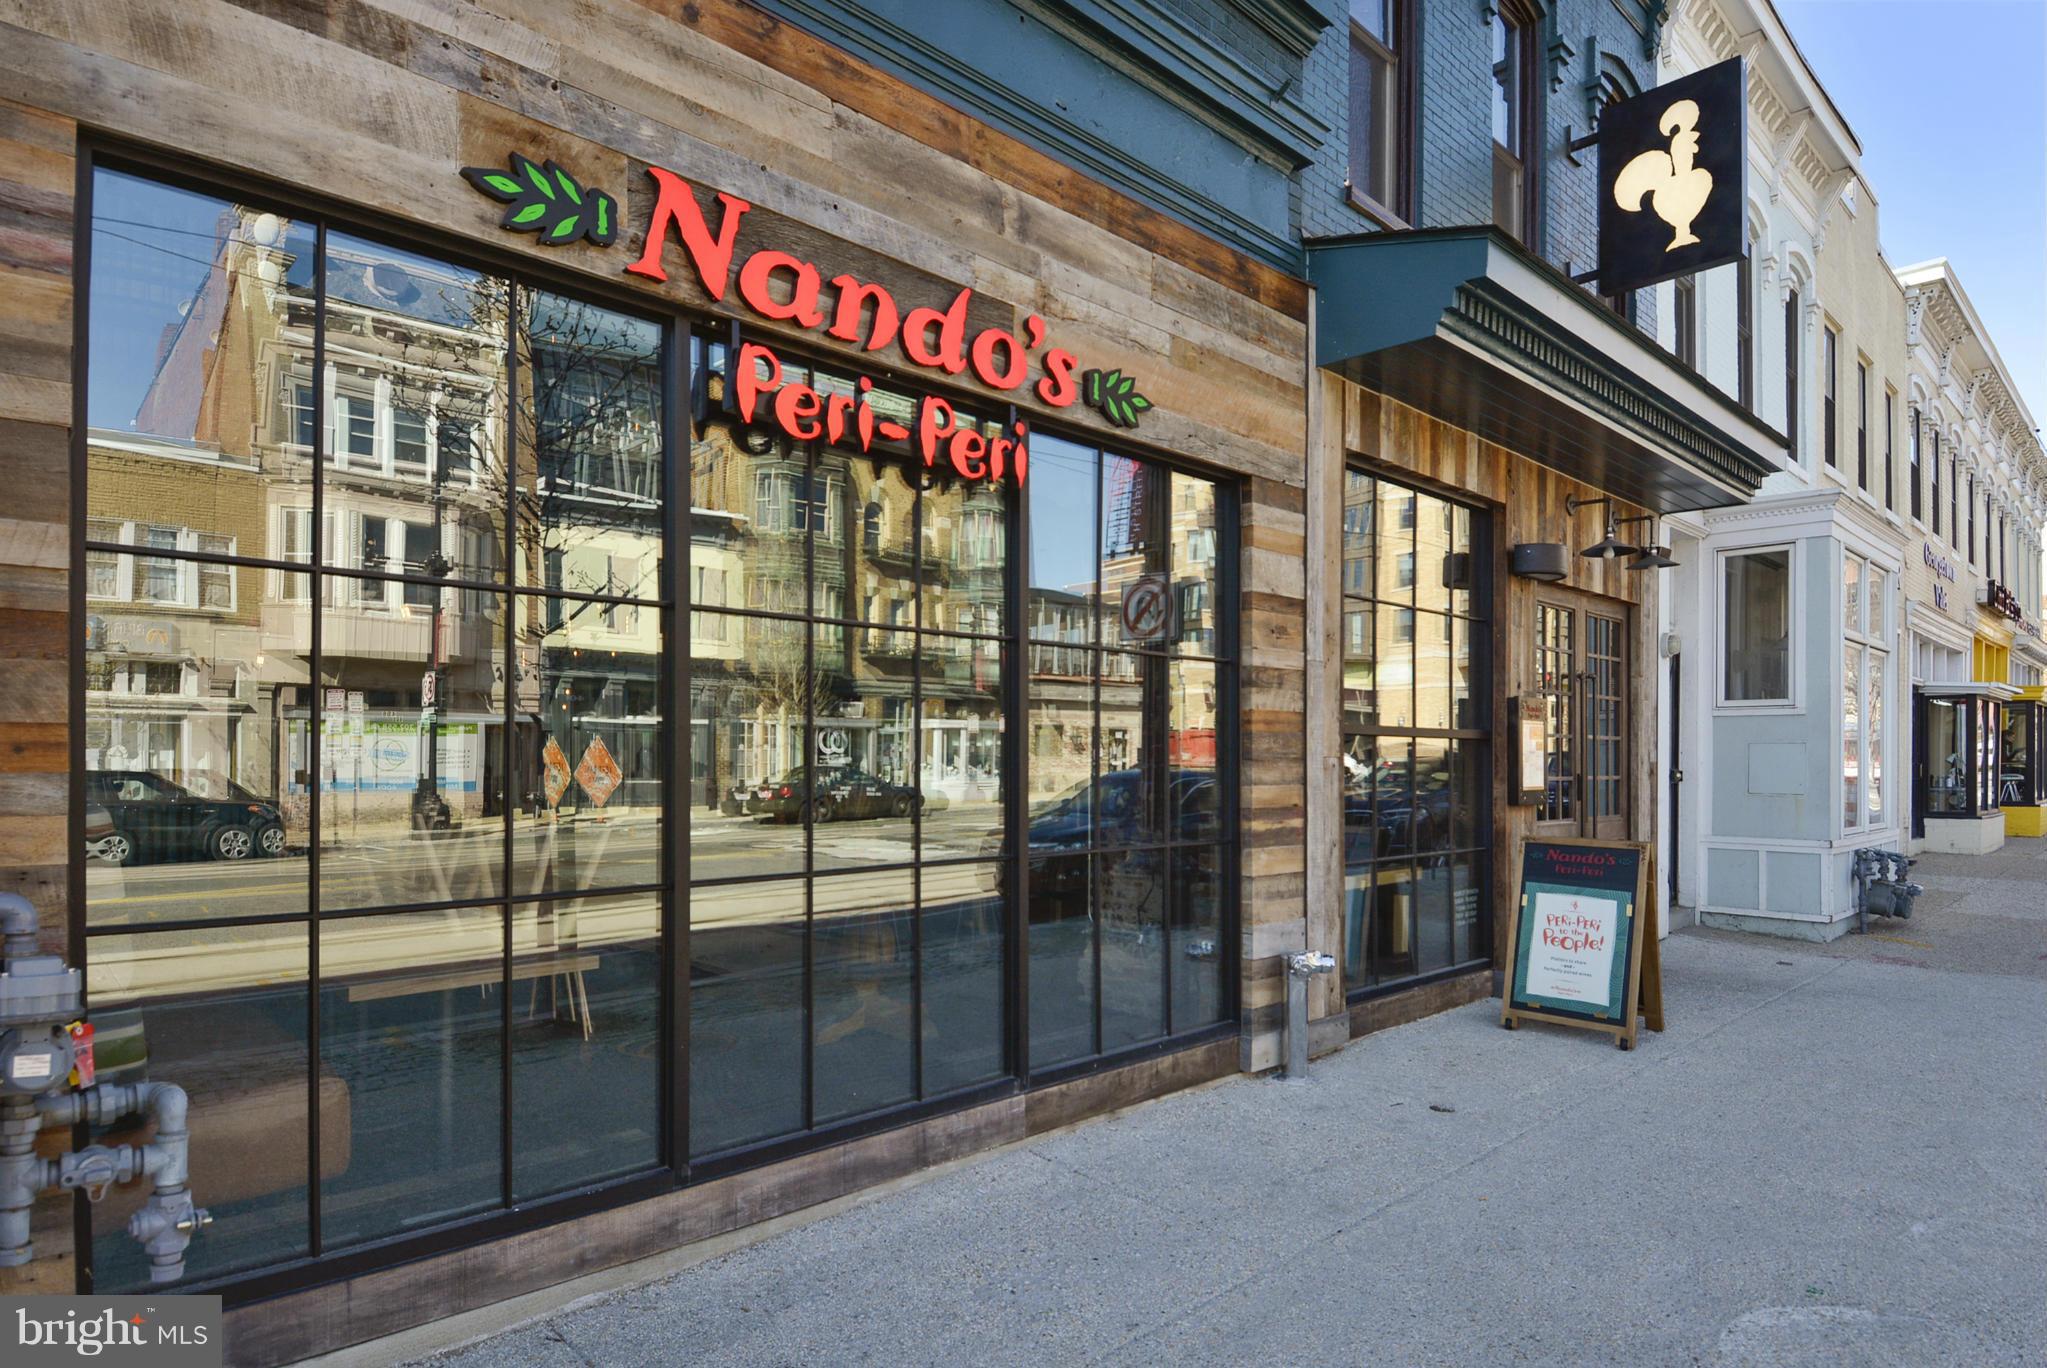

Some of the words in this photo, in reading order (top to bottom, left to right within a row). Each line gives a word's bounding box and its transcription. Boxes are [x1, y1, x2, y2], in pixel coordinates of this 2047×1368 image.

[625, 166, 1078, 407] Nando's
[735, 342, 1028, 488] Peri-Peri
[1546, 848, 1616, 865] Nando's
[1571, 928, 1583, 936] the
